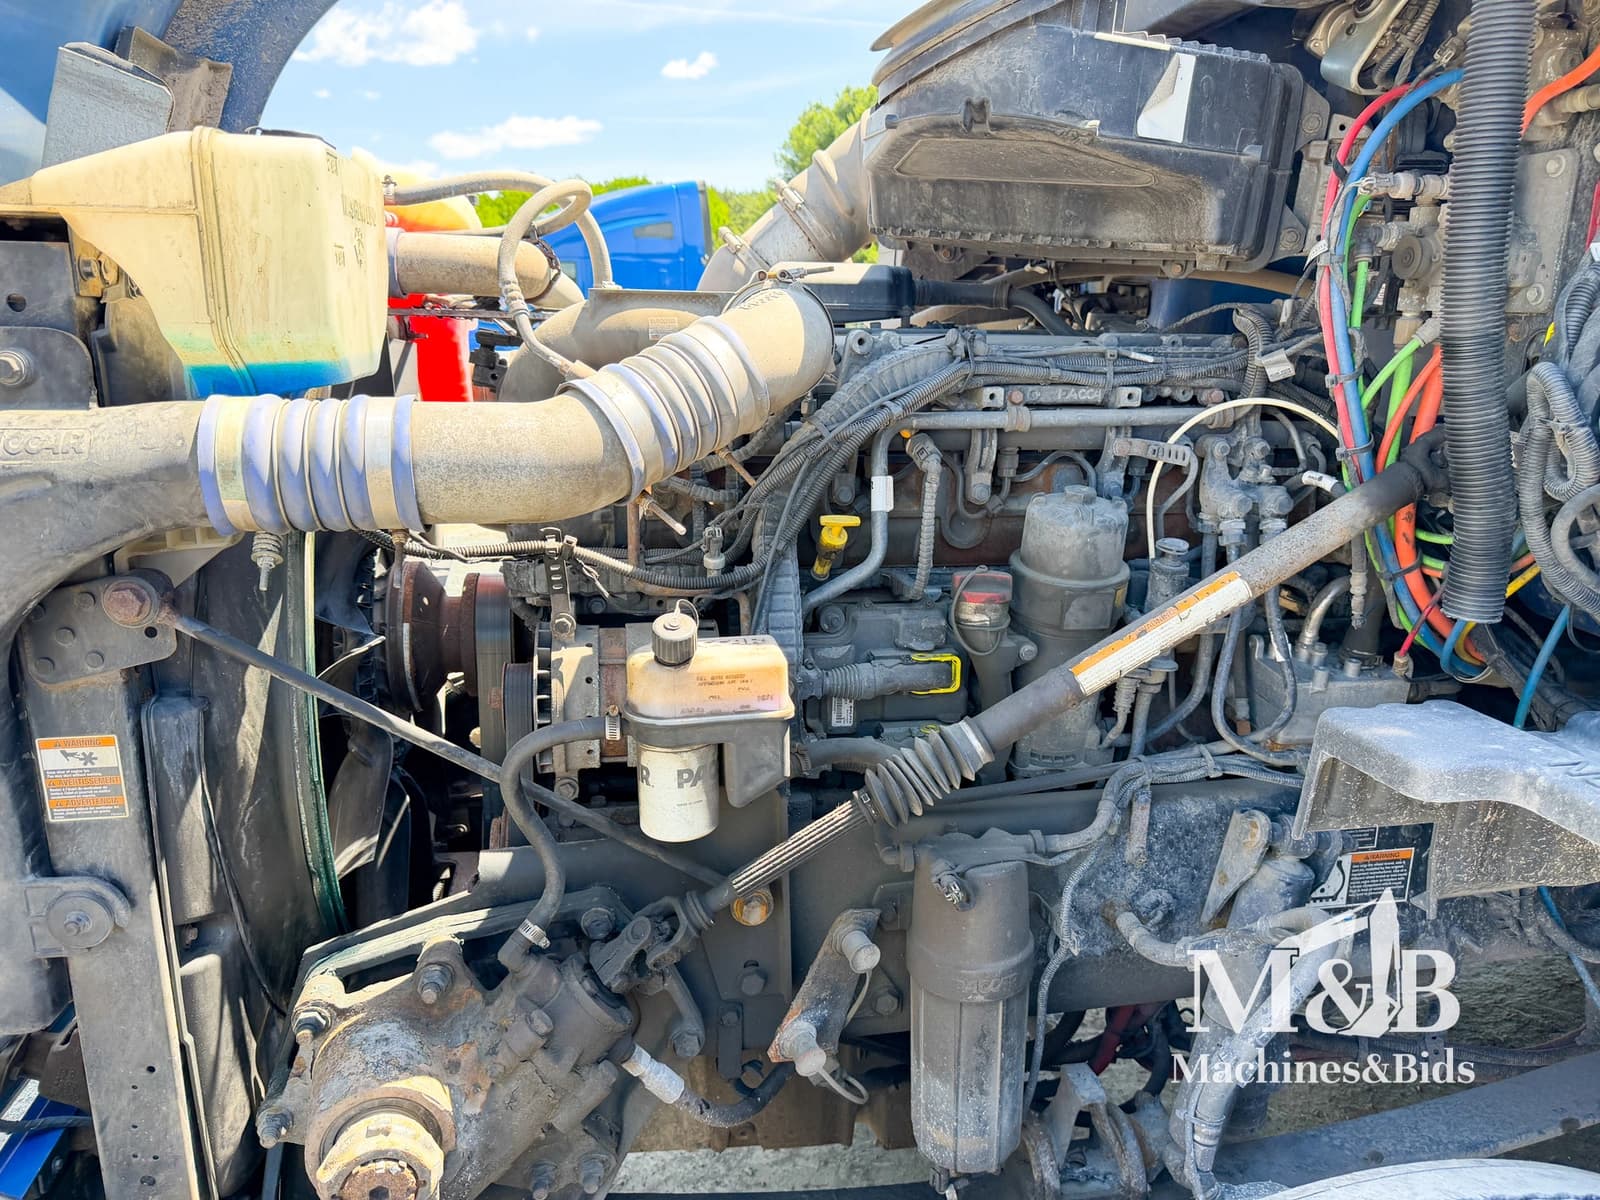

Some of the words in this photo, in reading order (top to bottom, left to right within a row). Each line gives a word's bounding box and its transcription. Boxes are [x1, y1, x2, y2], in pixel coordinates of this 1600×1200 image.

[0, 431, 84, 456] CCAR
[63, 737, 101, 747] WARNING
[57, 776, 120, 787] AVERTISSEMENT
[65, 796, 119, 807] ADVERTENCIA
[1368, 851, 1400, 860] WARNING
